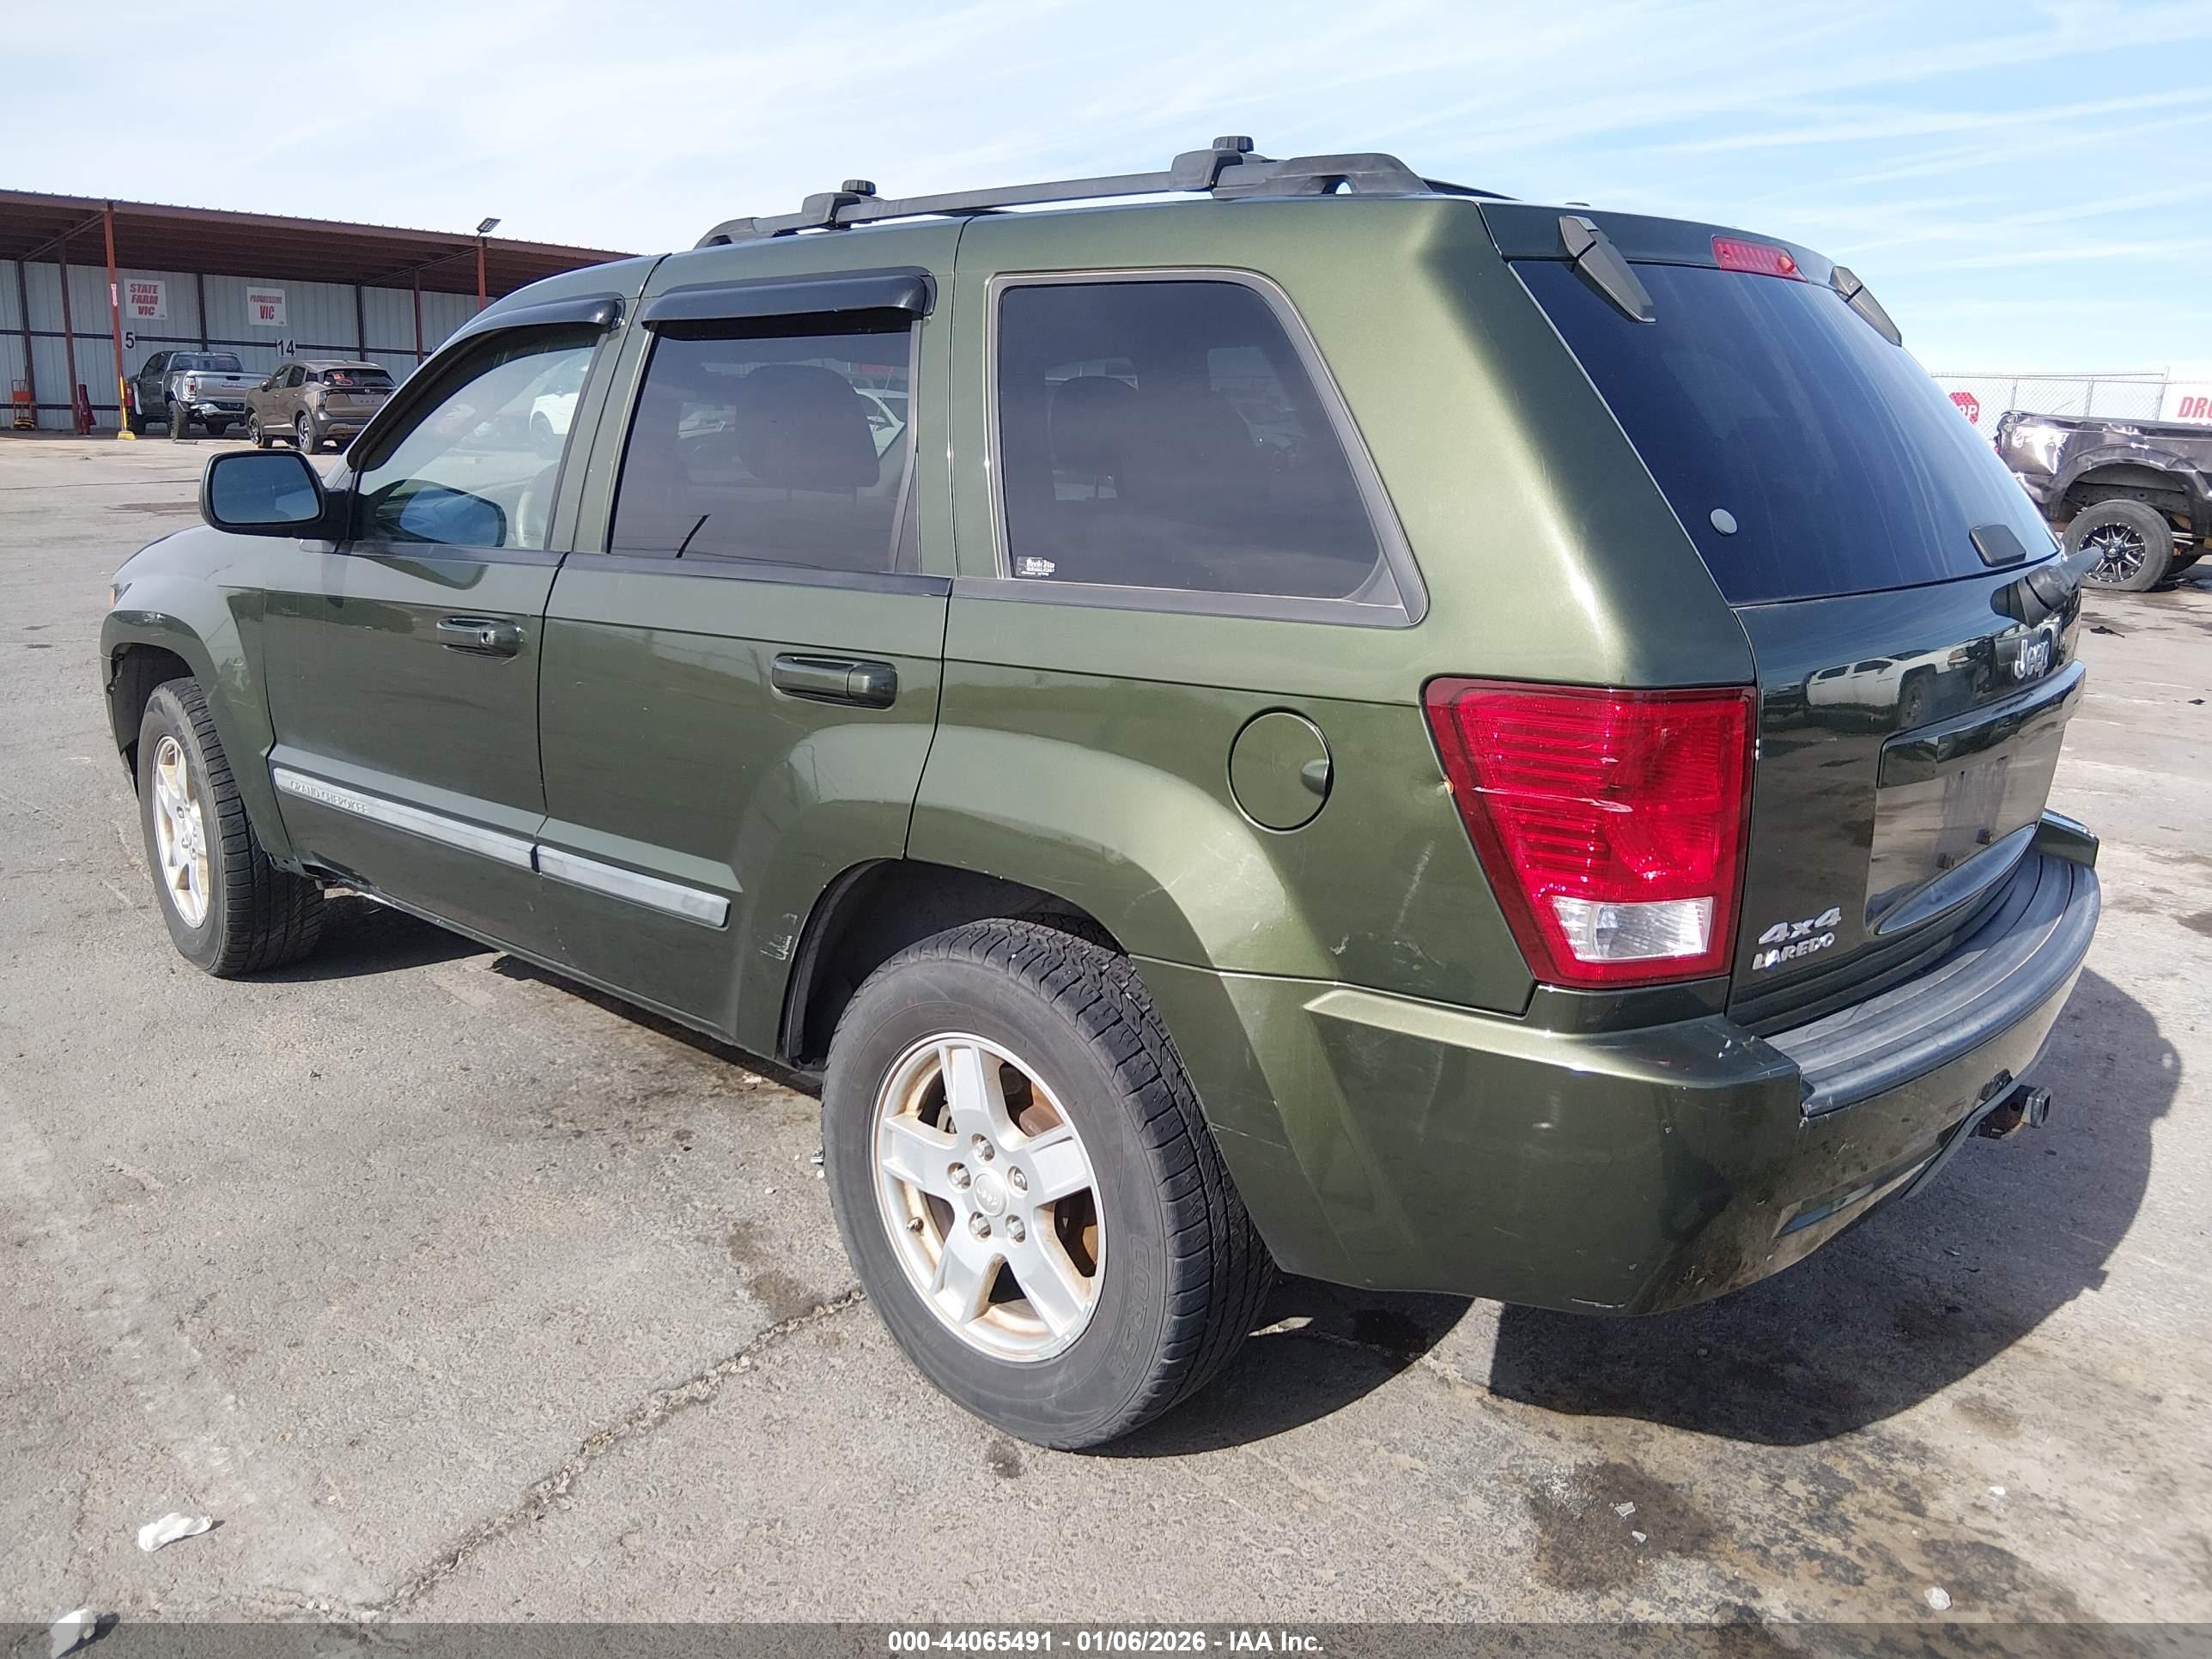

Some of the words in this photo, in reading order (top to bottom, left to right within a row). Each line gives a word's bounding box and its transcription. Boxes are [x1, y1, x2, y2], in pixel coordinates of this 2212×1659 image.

[130, 283, 158, 294] STATE
[131, 295, 158, 305] FARM
[250, 295, 283, 304] PROGRESSIVE
[138, 306, 155, 316] VIC
[259, 305, 275, 320] VIC
[125, 331, 135, 349] 5
[277, 339, 295, 356] 14
[2014, 639, 2050, 680] Jeep
[321, 791, 369, 814] CHEROKEE
[1758, 907, 1842, 945] 4x4
[1752, 932, 1835, 970] LAREDO
